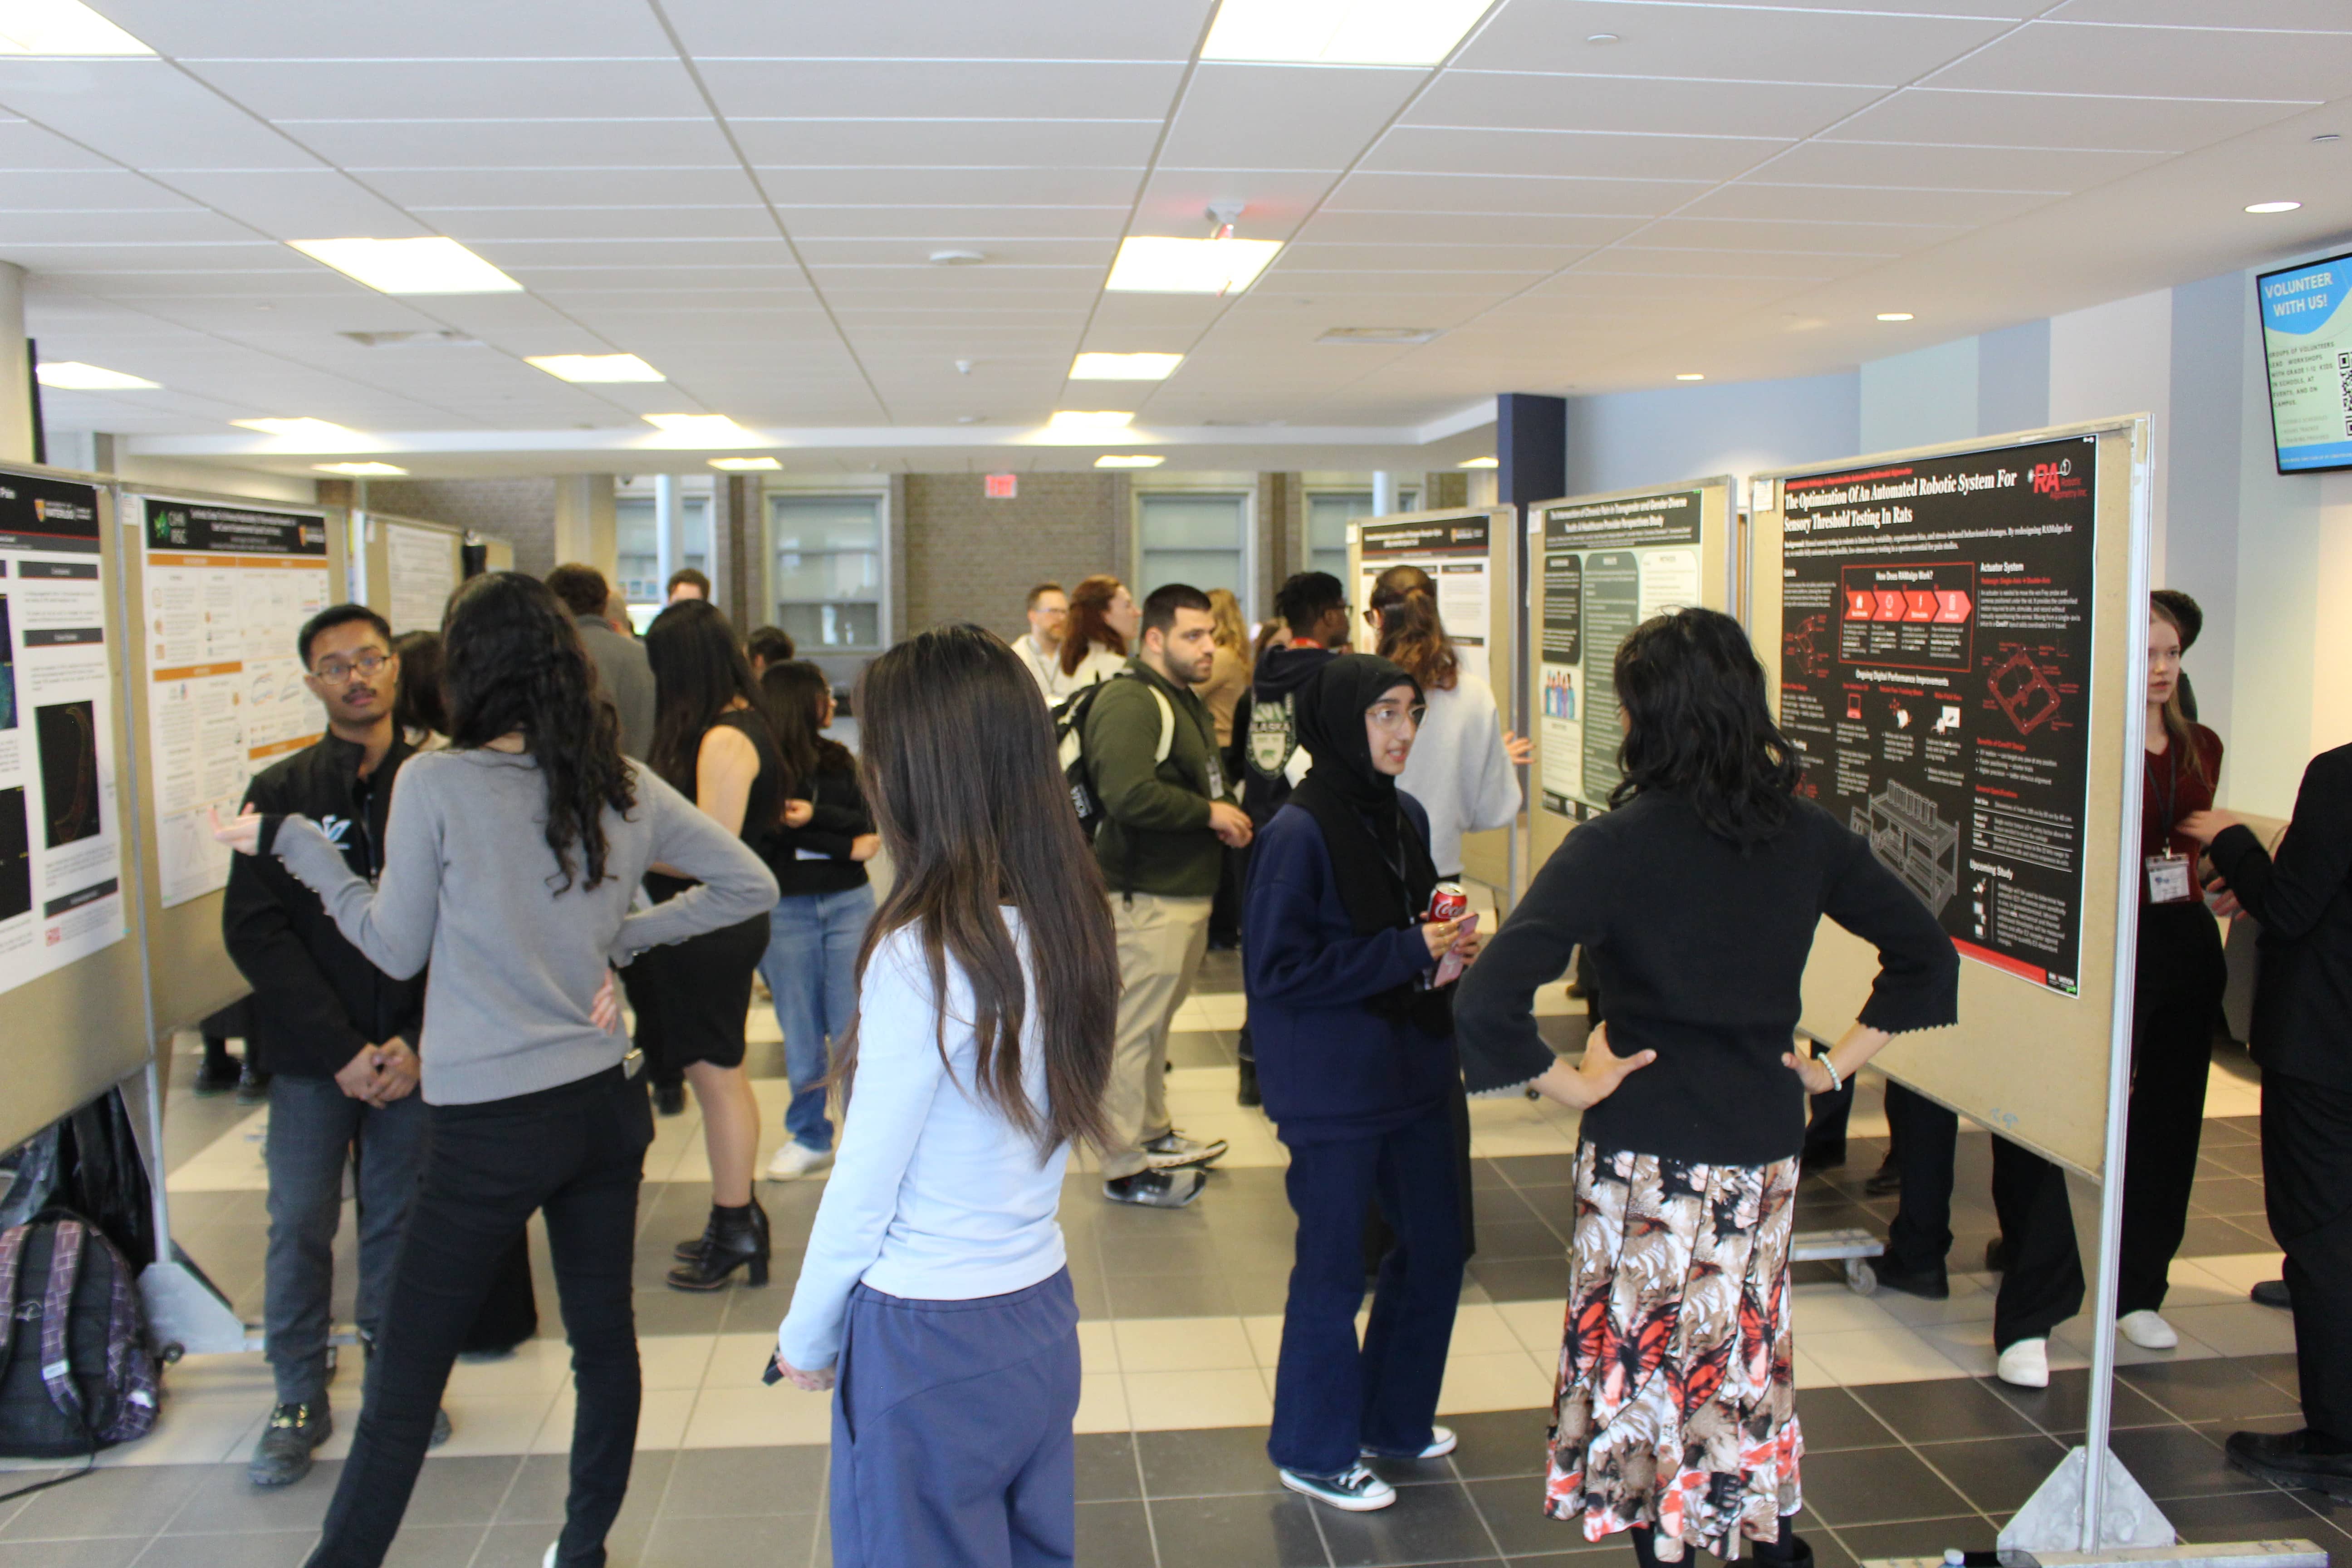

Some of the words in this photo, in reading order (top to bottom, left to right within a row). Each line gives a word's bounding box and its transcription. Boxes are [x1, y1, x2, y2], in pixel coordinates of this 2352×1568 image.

[2264, 272, 2333, 299] VOLUNTEER
[2273, 297, 2305, 317] WITH
[2308, 293, 2328, 309] US!
[1785, 493, 1798, 510] The
[1798, 488, 1847, 512] Optimization
[1848, 485, 1860, 504] Of
[1859, 485, 1870, 502] An
[1871, 477, 1917, 501] Automated
[1919, 474, 1956, 495] Robotic
[1958, 472, 1994, 496] System
[1997, 469, 2017, 488] For
[1784, 515, 1812, 534] Sensory
[1811, 510, 1850, 530] Threshold
[1851, 507, 1881, 529] Testing
[1881, 506, 1891, 524] In
[1892, 505, 1913, 524] Rats
[1980, 562, 2003, 572] Actuator
[2003, 561, 2024, 573] System
[1970, 858, 1997, 877] Upcoming
[1997, 865, 2014, 881] Study
